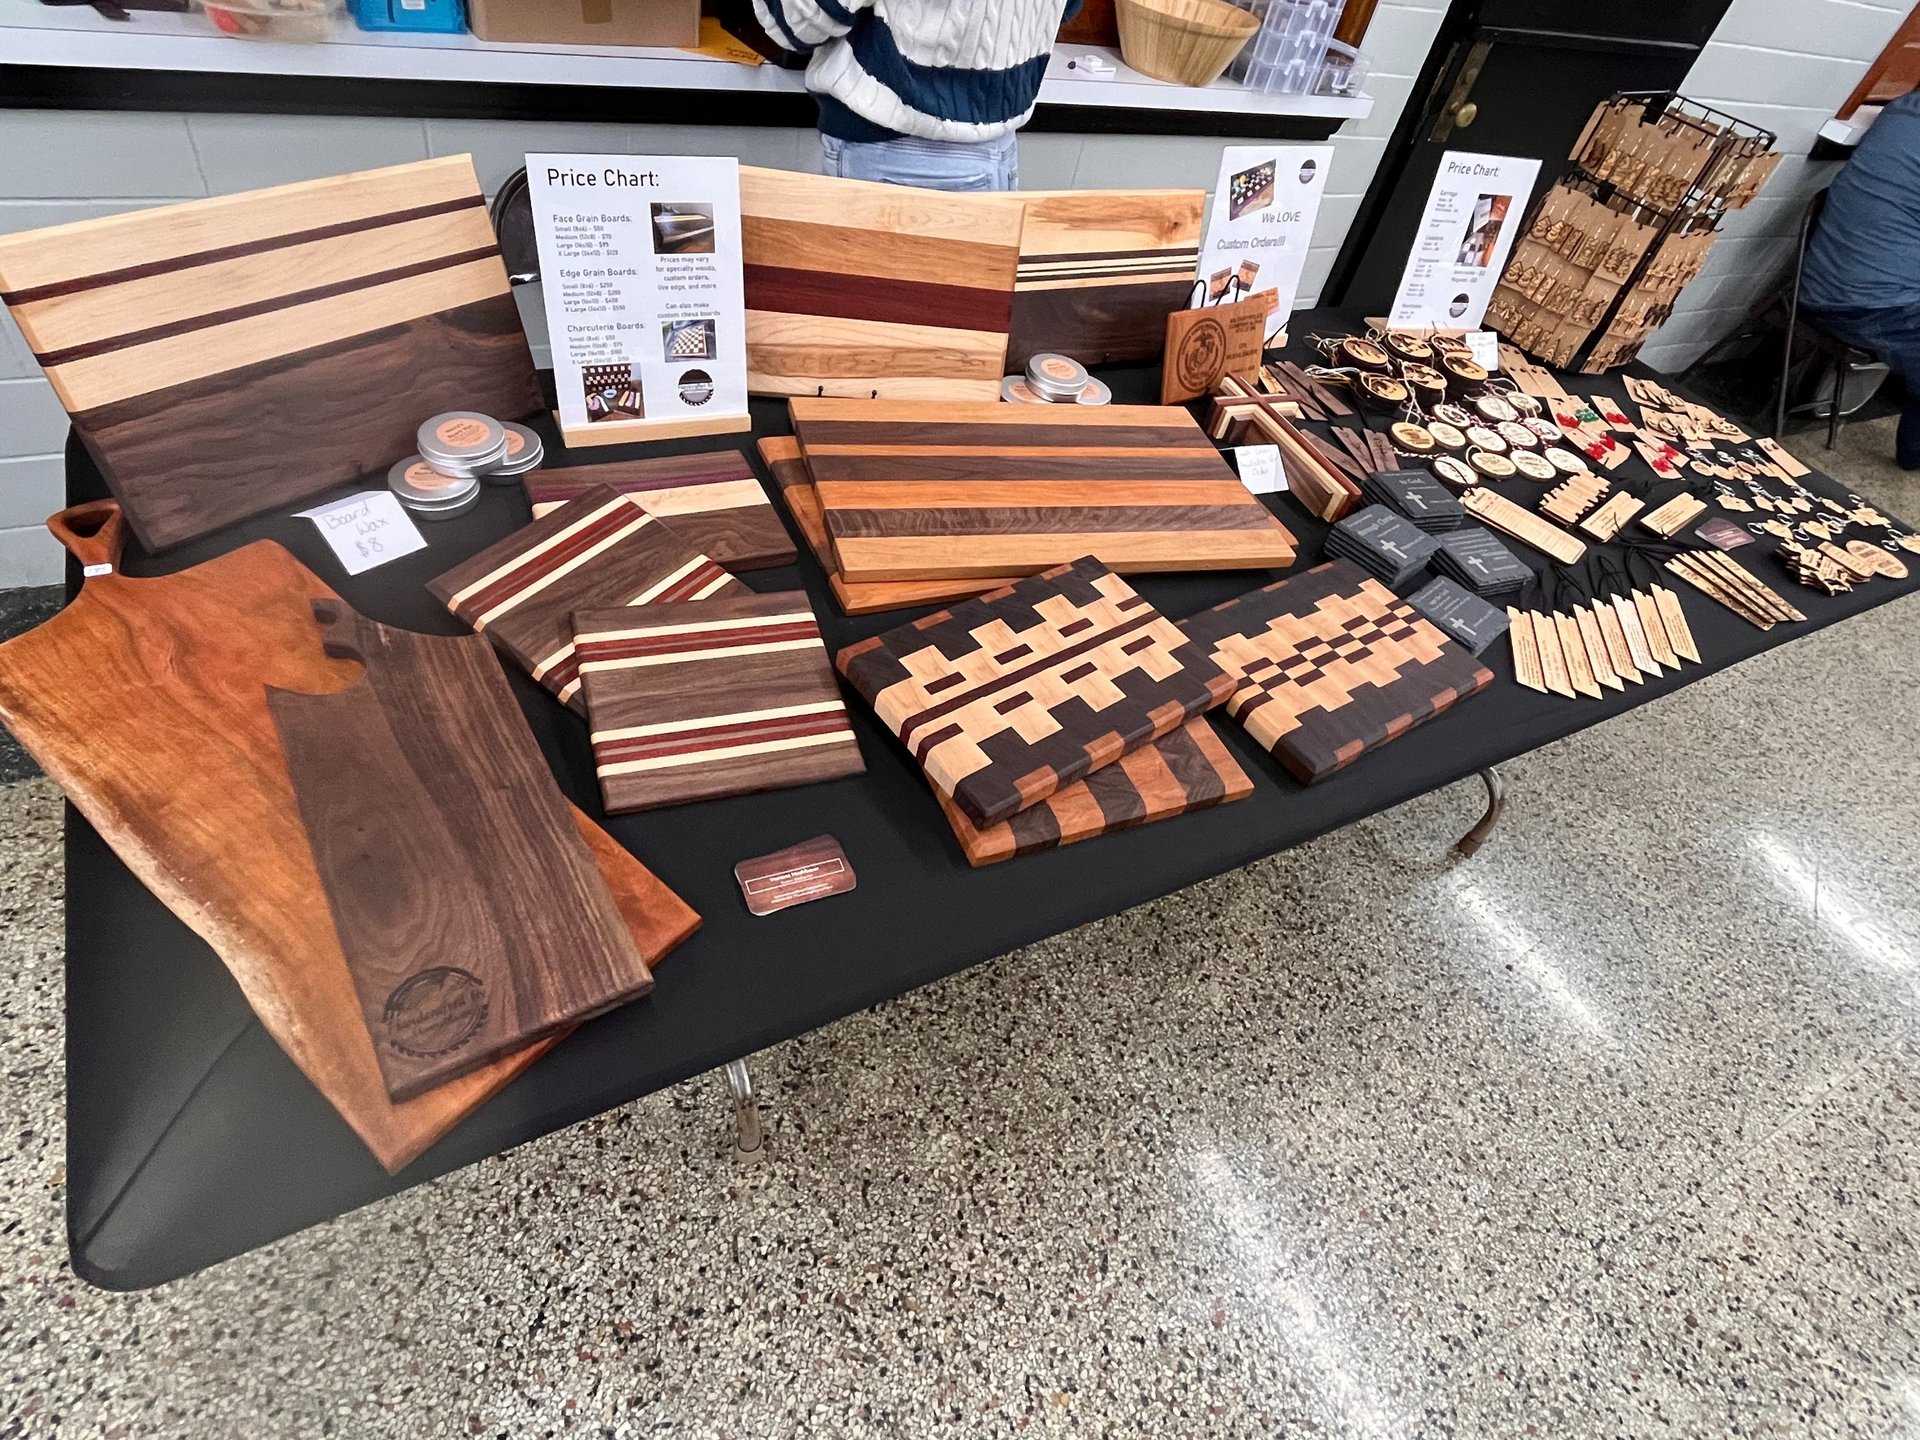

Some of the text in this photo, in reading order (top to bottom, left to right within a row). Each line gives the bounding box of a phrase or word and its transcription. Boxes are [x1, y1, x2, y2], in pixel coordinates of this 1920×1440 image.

[1447, 161, 1501, 177] Price Chart:
[547, 168, 660, 187] Price Chart:
[553, 214, 633, 223] Face Grain Boards:
[1262, 212, 1302, 223] We LOVE
[1217, 239, 1249, 250] Custom
[560, 268, 638, 279] Edge Grain Boards:
[567, 323, 615, 333] Charcuterie
[322, 500, 370, 530] Board
[355, 517, 390, 536] Wax
[355, 537, 384, 559] $8
